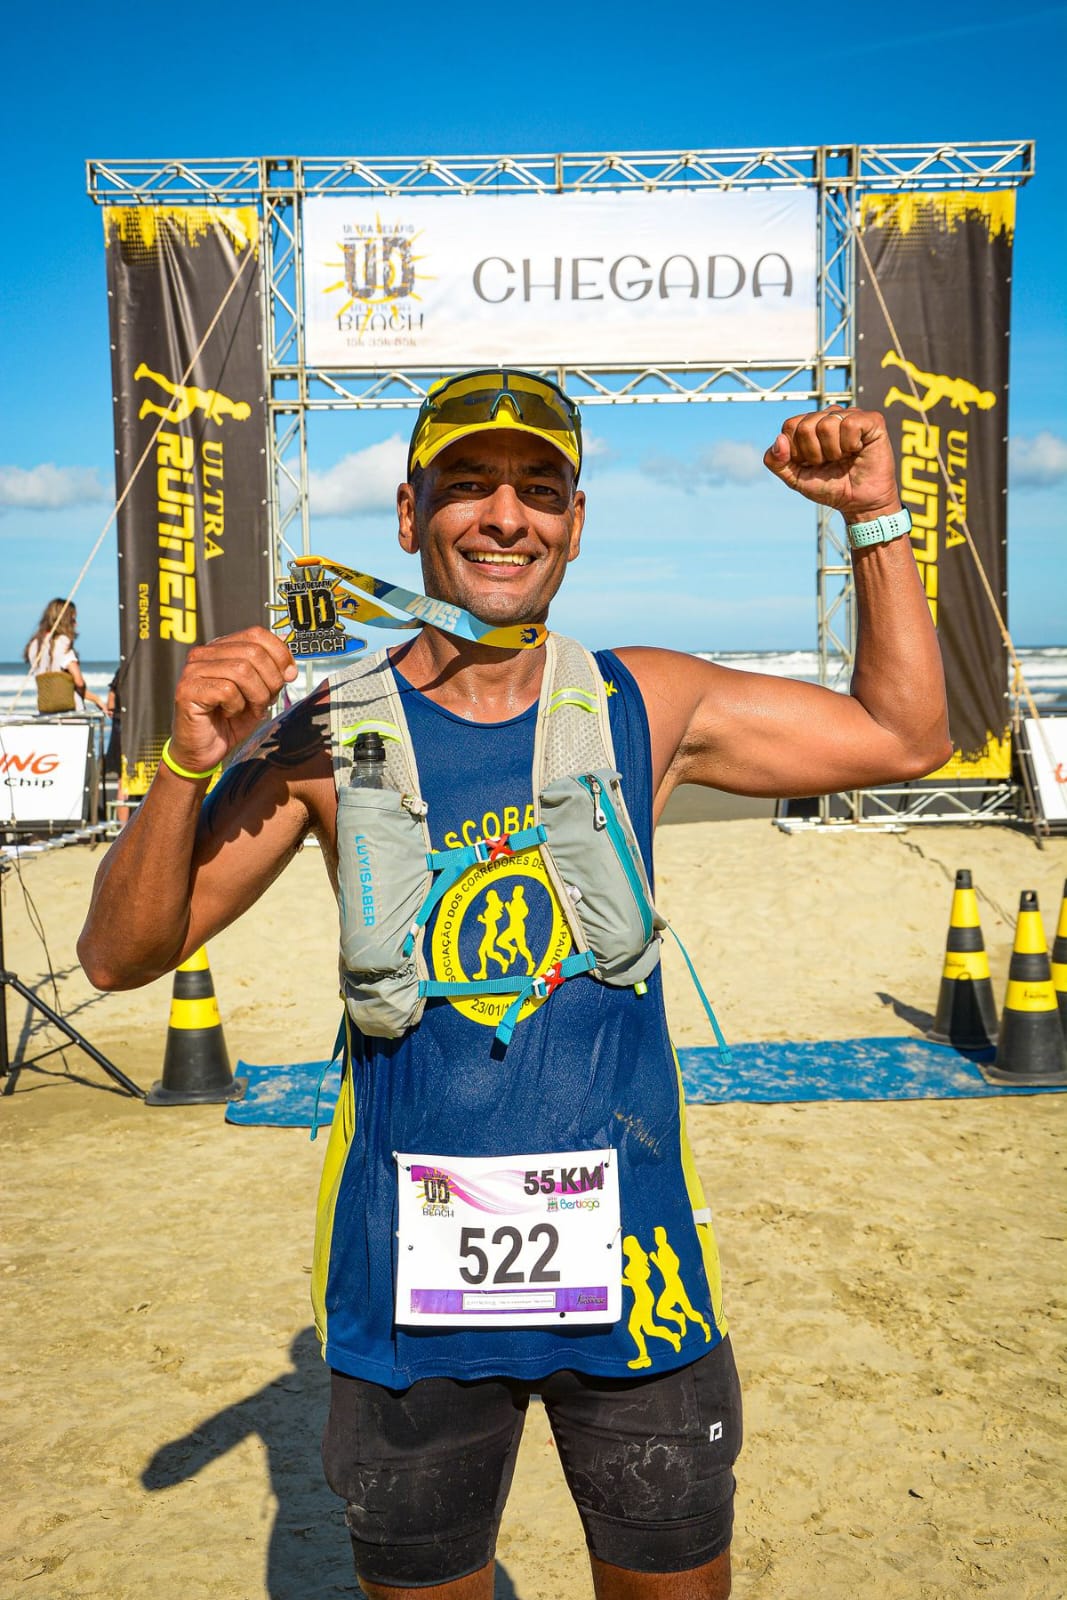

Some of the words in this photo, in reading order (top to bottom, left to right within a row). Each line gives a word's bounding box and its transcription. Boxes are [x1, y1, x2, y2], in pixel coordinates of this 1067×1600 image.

[343, 236, 415, 299] UD
[472, 252, 794, 304] CHEGADA
[337, 312, 424, 331] BEACH
[201, 440, 225, 561] ULTRA
[945, 429, 968, 549] ULTRA
[156, 431, 197, 645] RUNNER
[901, 419, 940, 628] RUNN
[138, 582, 150, 641] EVENTOS
[287, 589, 336, 631] UD
[288, 637, 345, 655] BEACH
[4, 777, 54, 789] Chip
[354, 833, 376, 928] LUYISABER
[461, 856, 530, 893] CORREDORES
[447, 892, 464, 919] DOS
[441, 920, 457, 982] SOCIAÇÃO
[471, 997, 531, 1017] 23/01/
[524, 1169, 556, 1195] 55
[560, 1166, 603, 1192] KM
[422, 1206, 455, 1218] BEACH
[560, 1198, 600, 1211] Bertioga
[459, 1223, 561, 1285] 522
